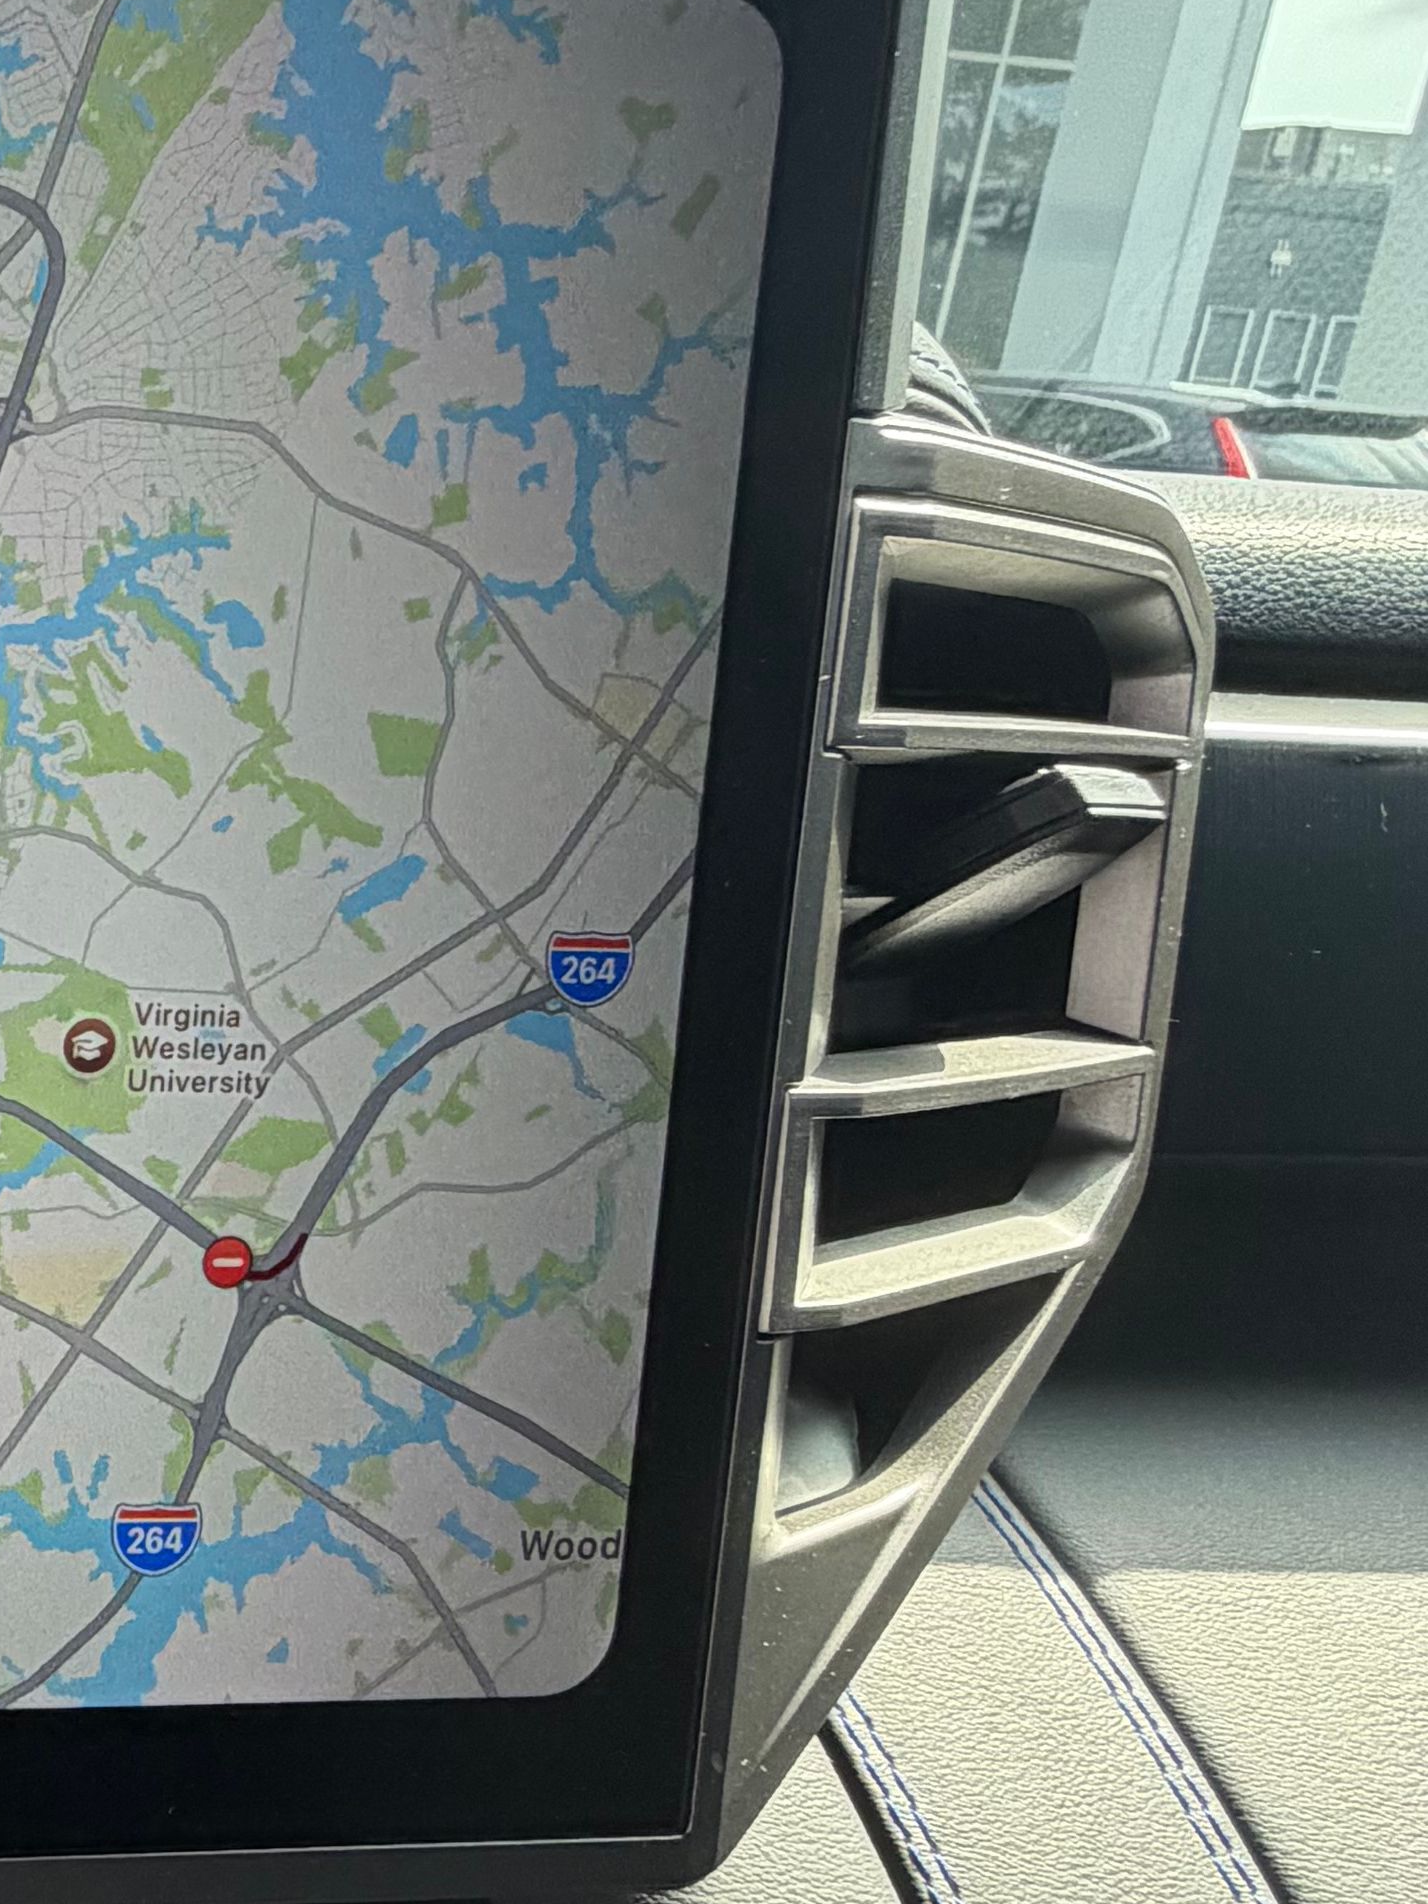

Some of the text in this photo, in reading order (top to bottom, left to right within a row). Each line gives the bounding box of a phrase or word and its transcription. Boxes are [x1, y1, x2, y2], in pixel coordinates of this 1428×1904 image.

[561, 956, 616, 987] 264
[135, 1001, 241, 1034] Virginia
[132, 1034, 266, 1066] Wesleyan
[128, 1068, 271, 1099] University
[125, 1525, 184, 1555] 264
[521, 1528, 622, 1561] Wood
